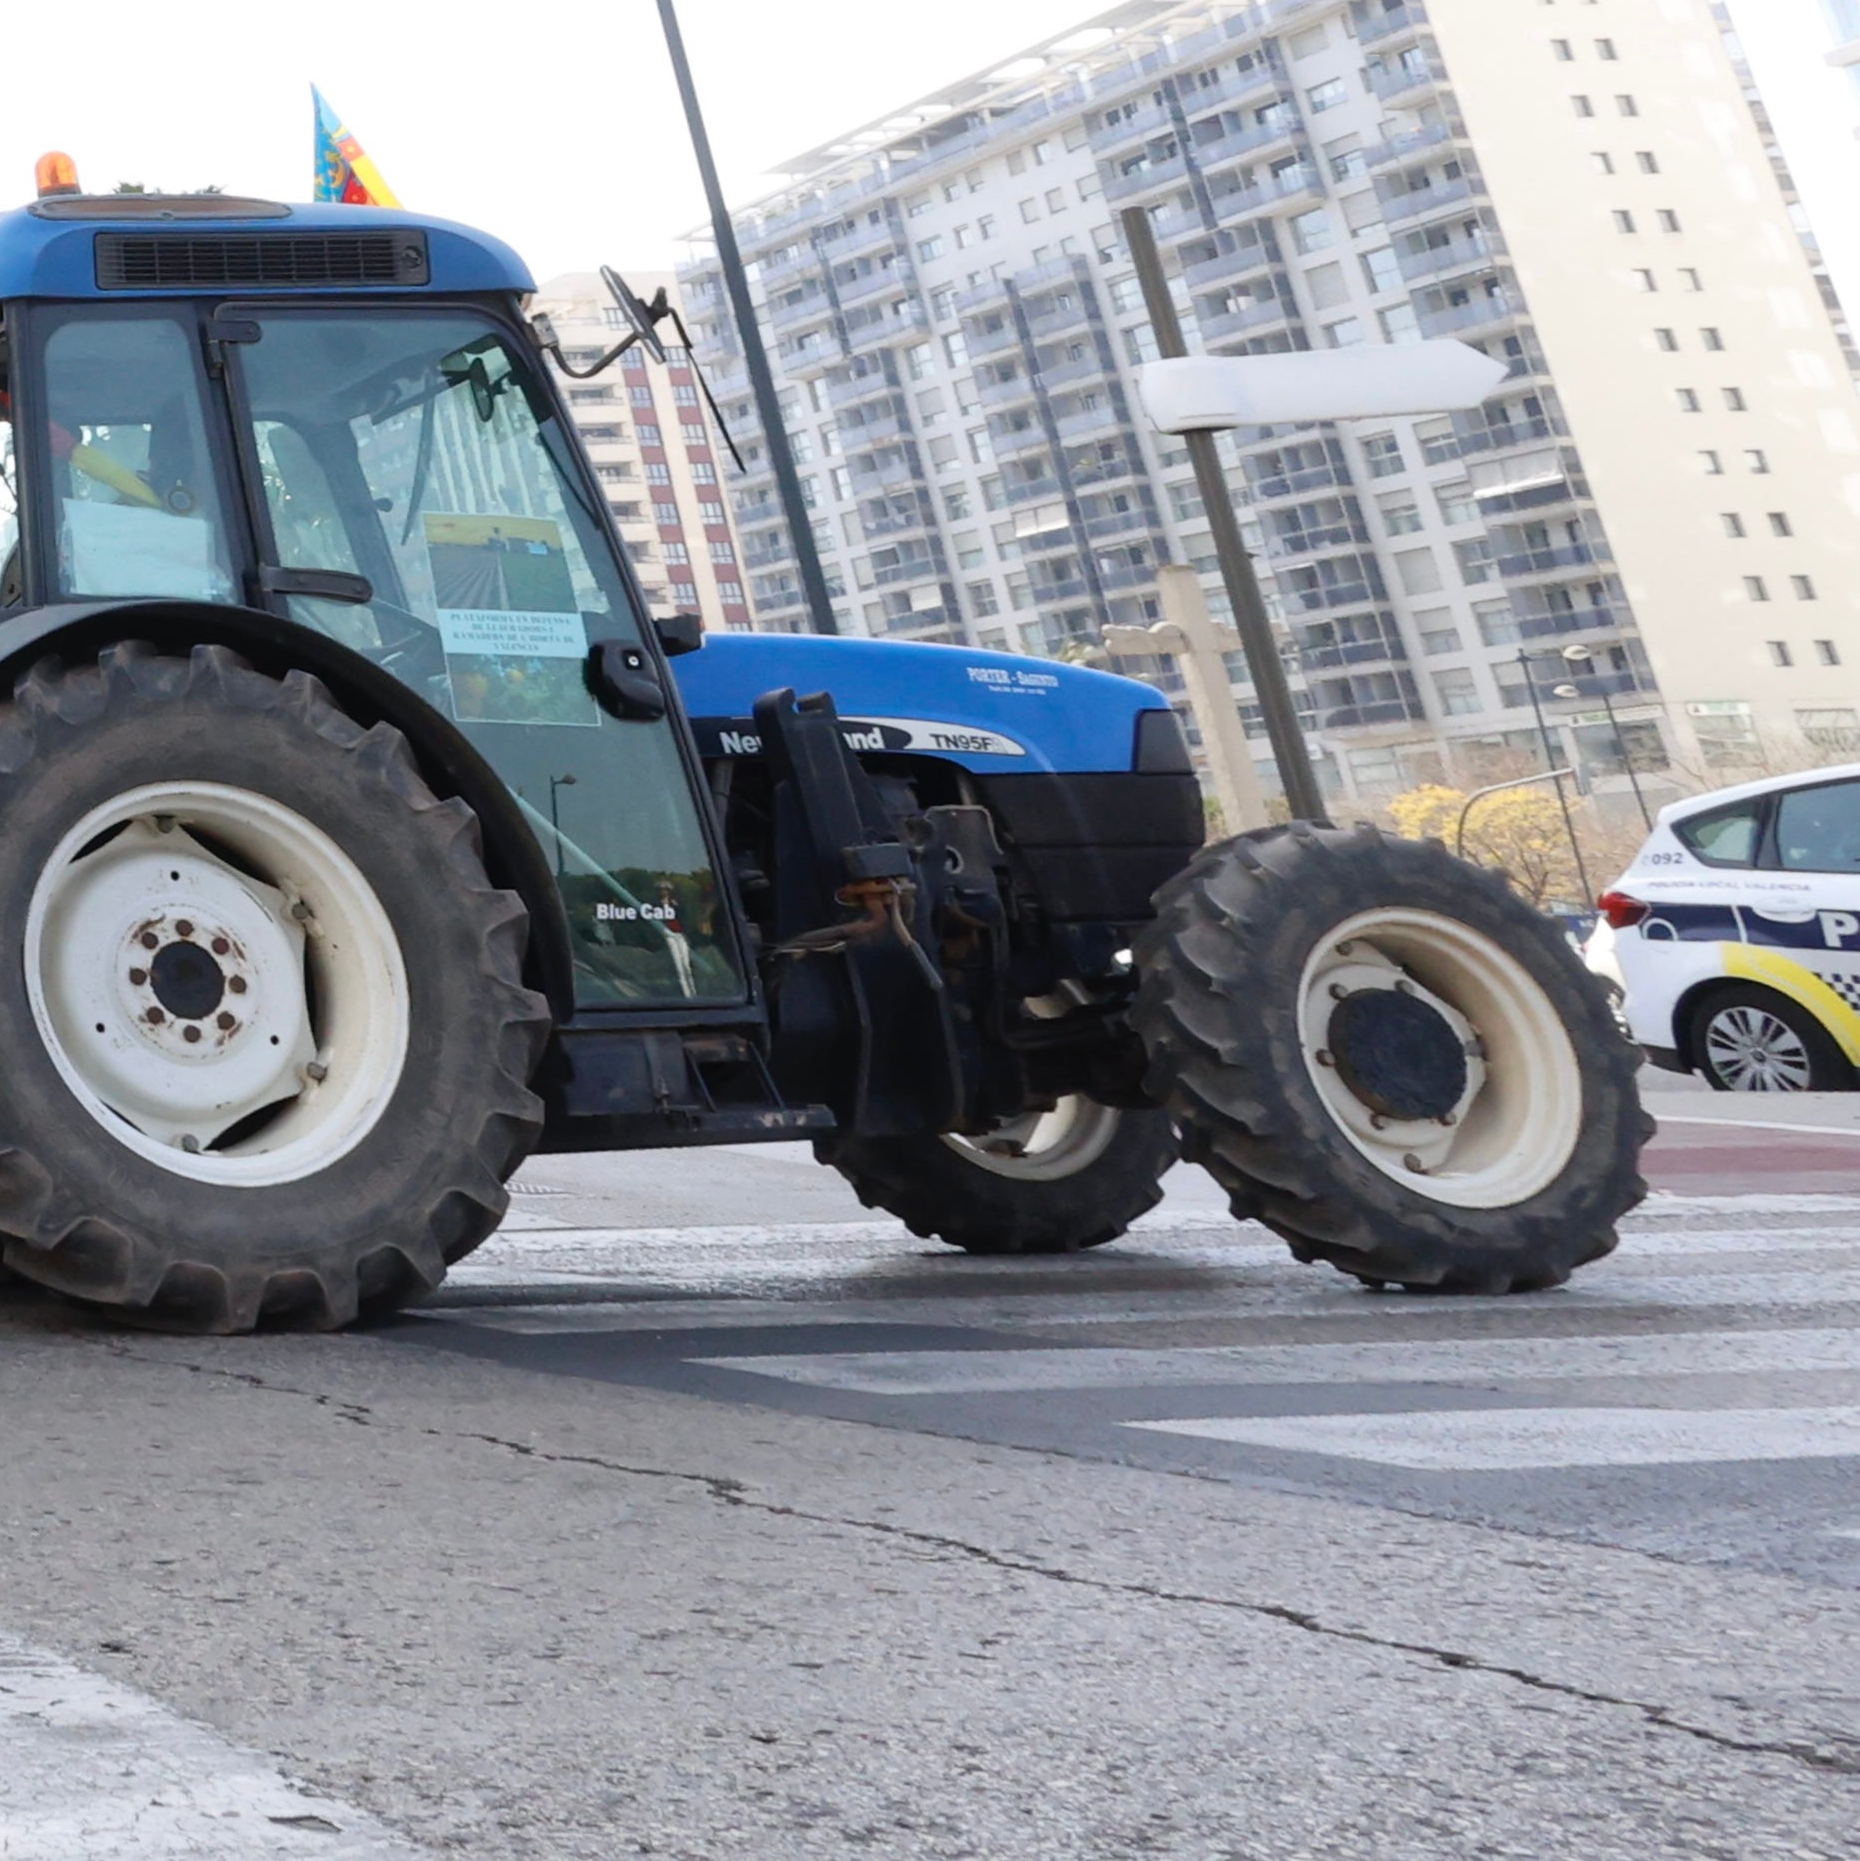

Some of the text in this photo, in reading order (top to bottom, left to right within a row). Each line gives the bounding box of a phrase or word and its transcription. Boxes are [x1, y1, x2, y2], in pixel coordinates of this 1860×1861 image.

[719, 731, 762, 754] Ne
[1651, 853, 1684, 865] 092
[596, 903, 676, 920] Blue Cab
